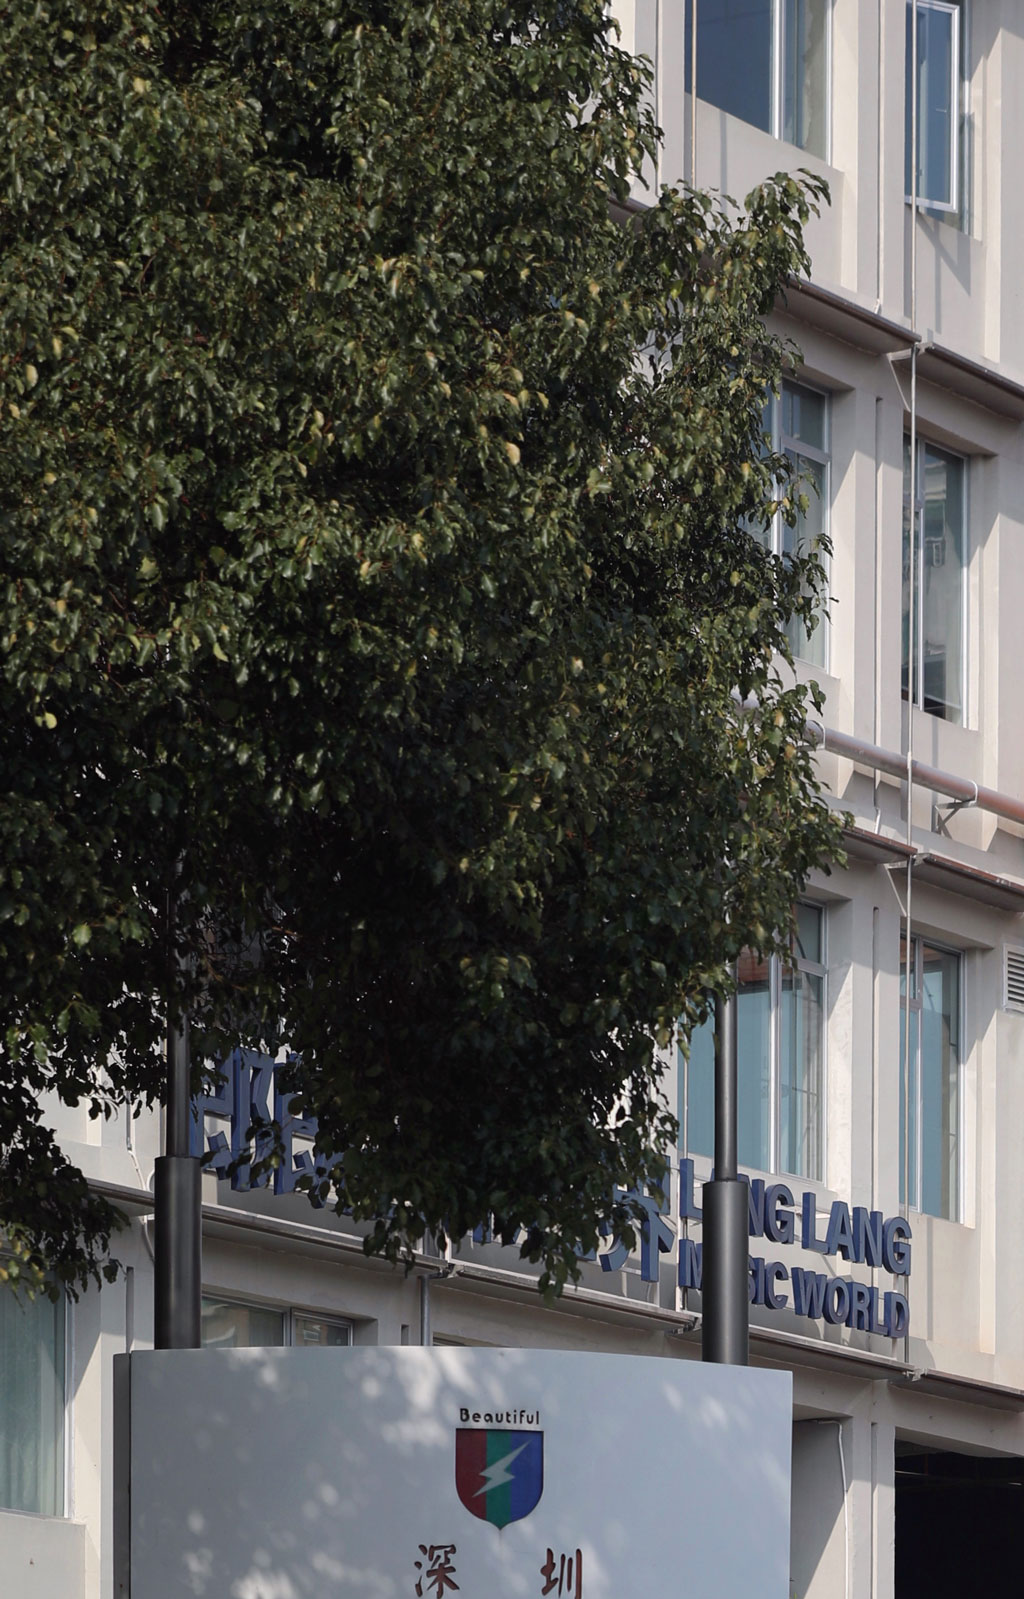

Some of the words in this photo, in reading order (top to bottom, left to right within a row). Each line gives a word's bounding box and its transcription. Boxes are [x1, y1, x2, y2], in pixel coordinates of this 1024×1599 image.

[680, 1157, 795, 1244] LNG
[802, 1192, 913, 1276] LANG
[678, 1238, 788, 1309] MIC
[790, 1266, 910, 1338] WORLD
[459, 1406, 540, 1426] Beautiful
